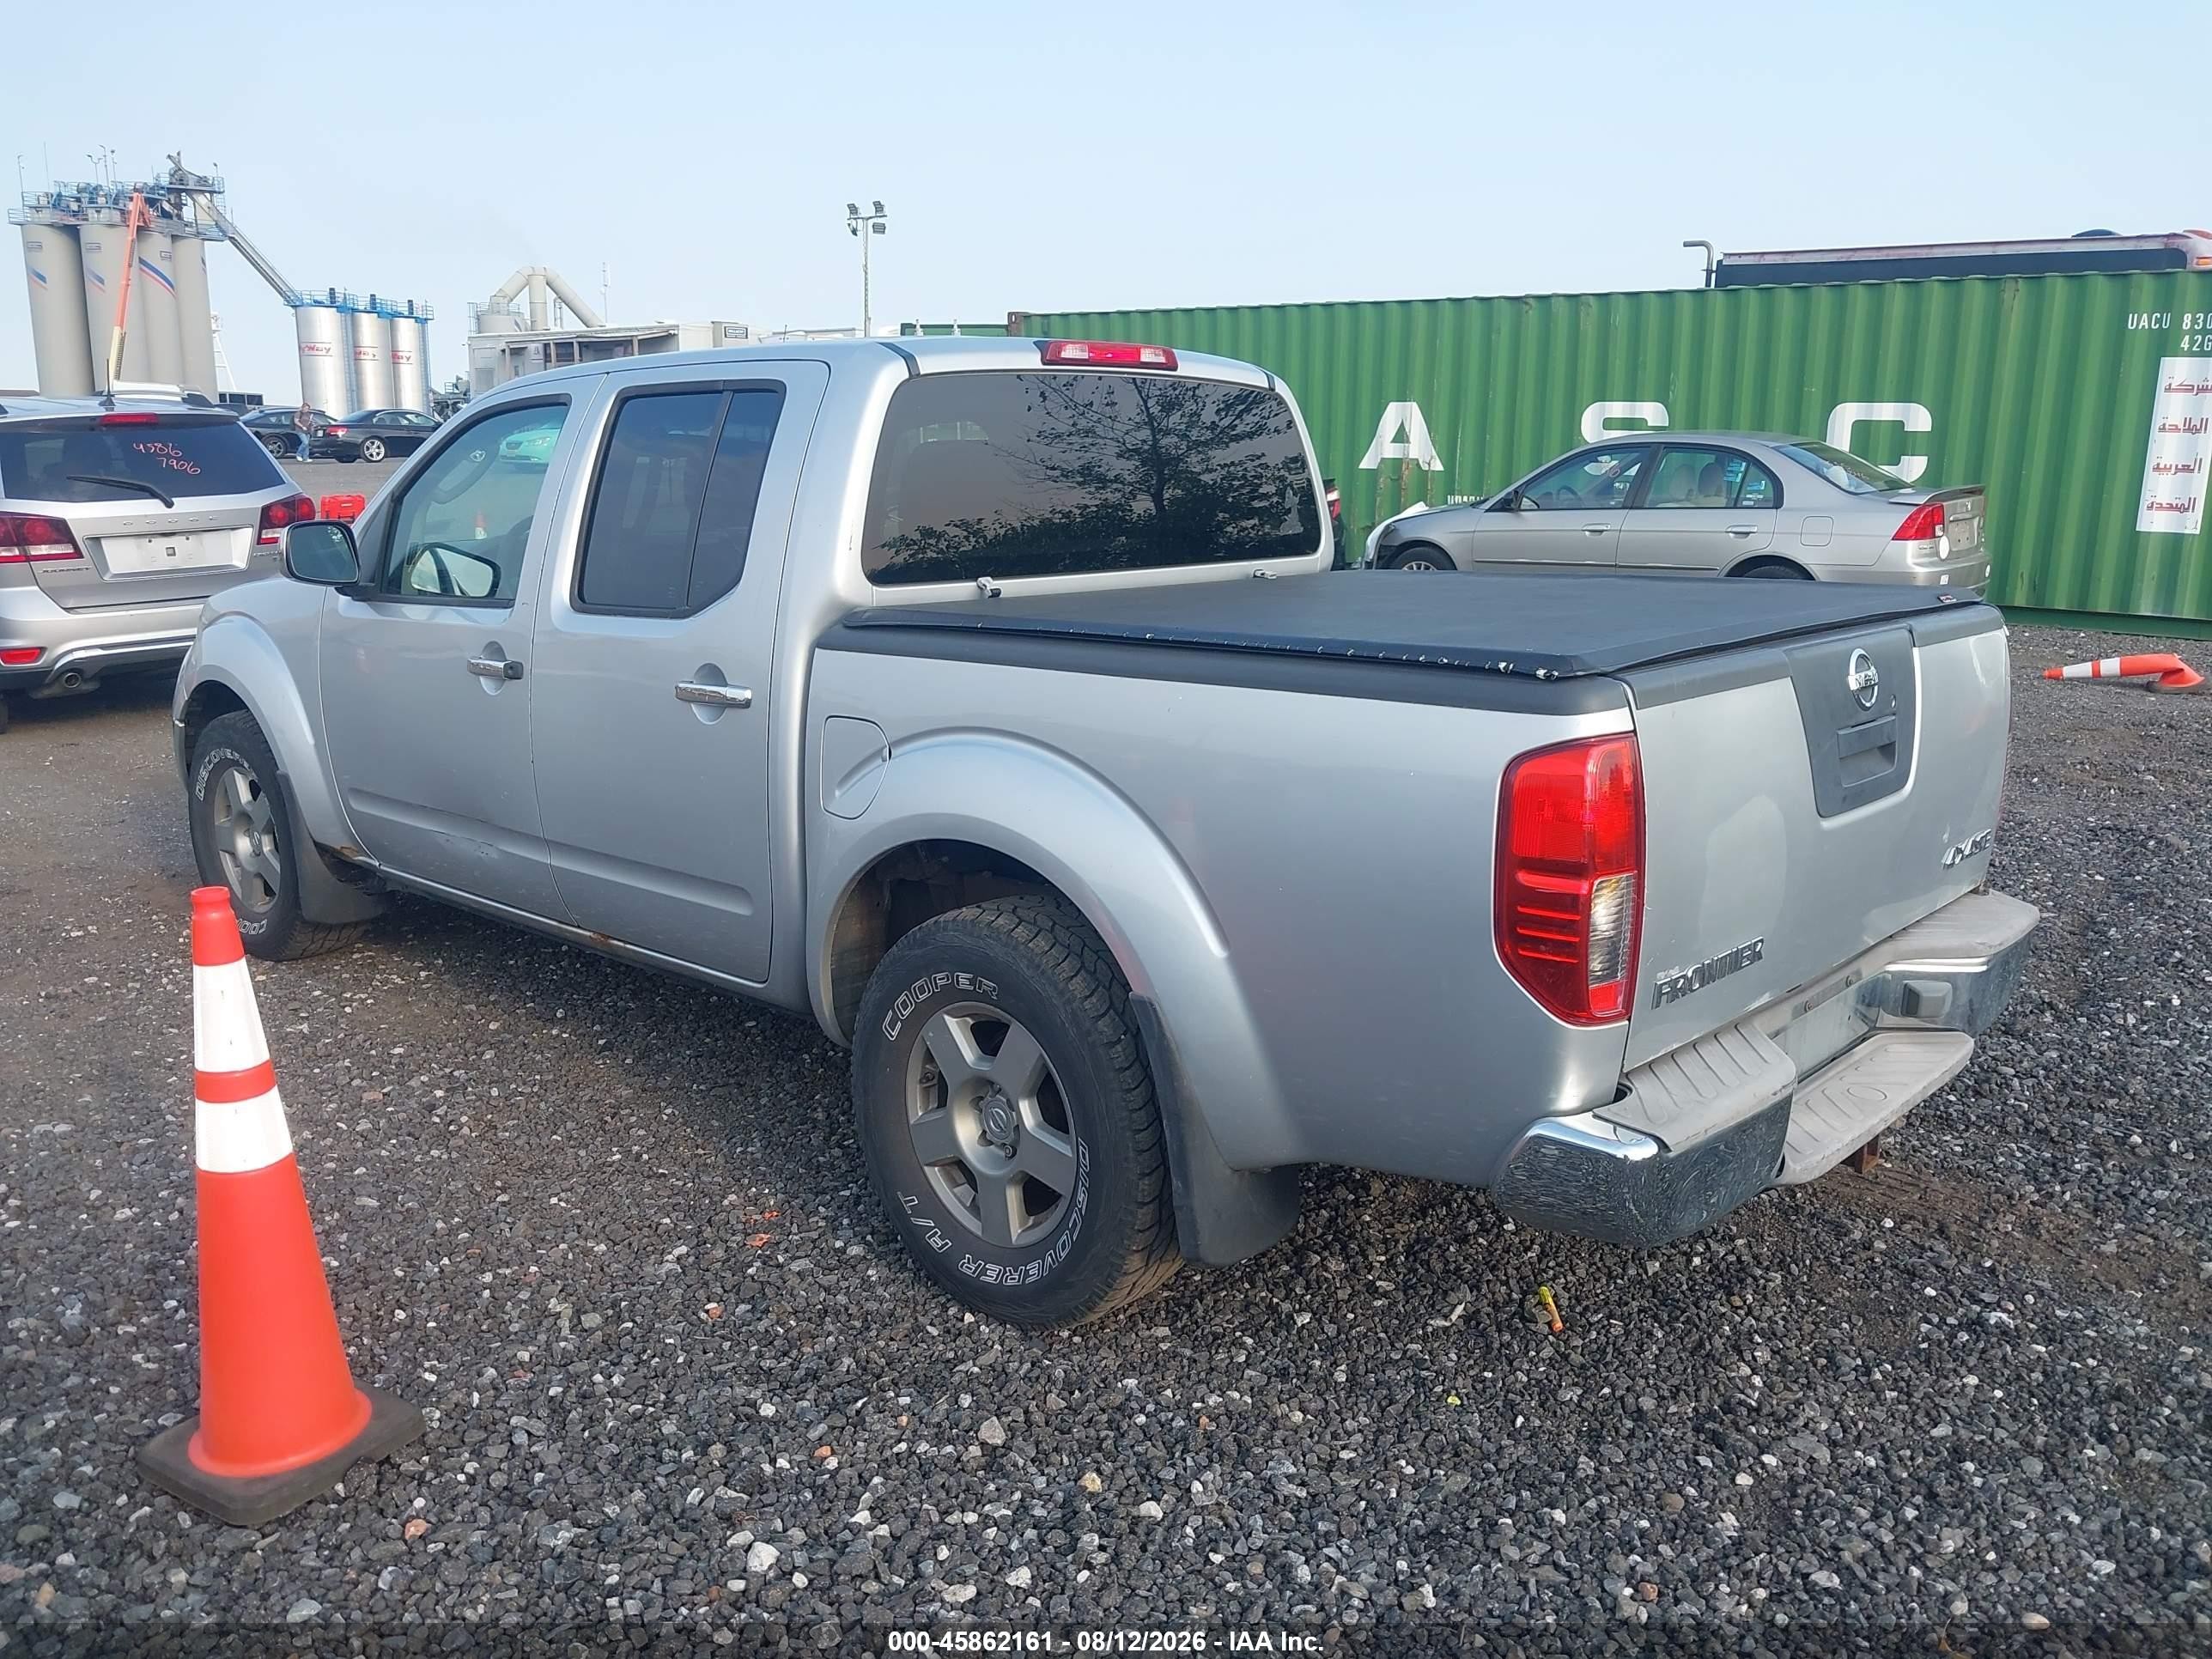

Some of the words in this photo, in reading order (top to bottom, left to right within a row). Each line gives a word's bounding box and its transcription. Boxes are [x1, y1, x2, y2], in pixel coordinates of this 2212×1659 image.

[2127, 313, 2171, 330] UACU
[2180, 334, 2212, 351] 42G
[2157, 416, 2209, 435] الملاحة
[132, 441, 183, 457] 4586
[156, 457, 202, 475] 7906
[2151, 453, 2203, 476] العربية
[2145, 495, 2197, 514] المتحدة
[1651, 935, 1765, 1010] FRONTIER
[882, 971, 999, 1042] COOPER
[957, 1137, 1091, 1286] DISCOVERER
[896, 1190, 952, 1254] A/T
